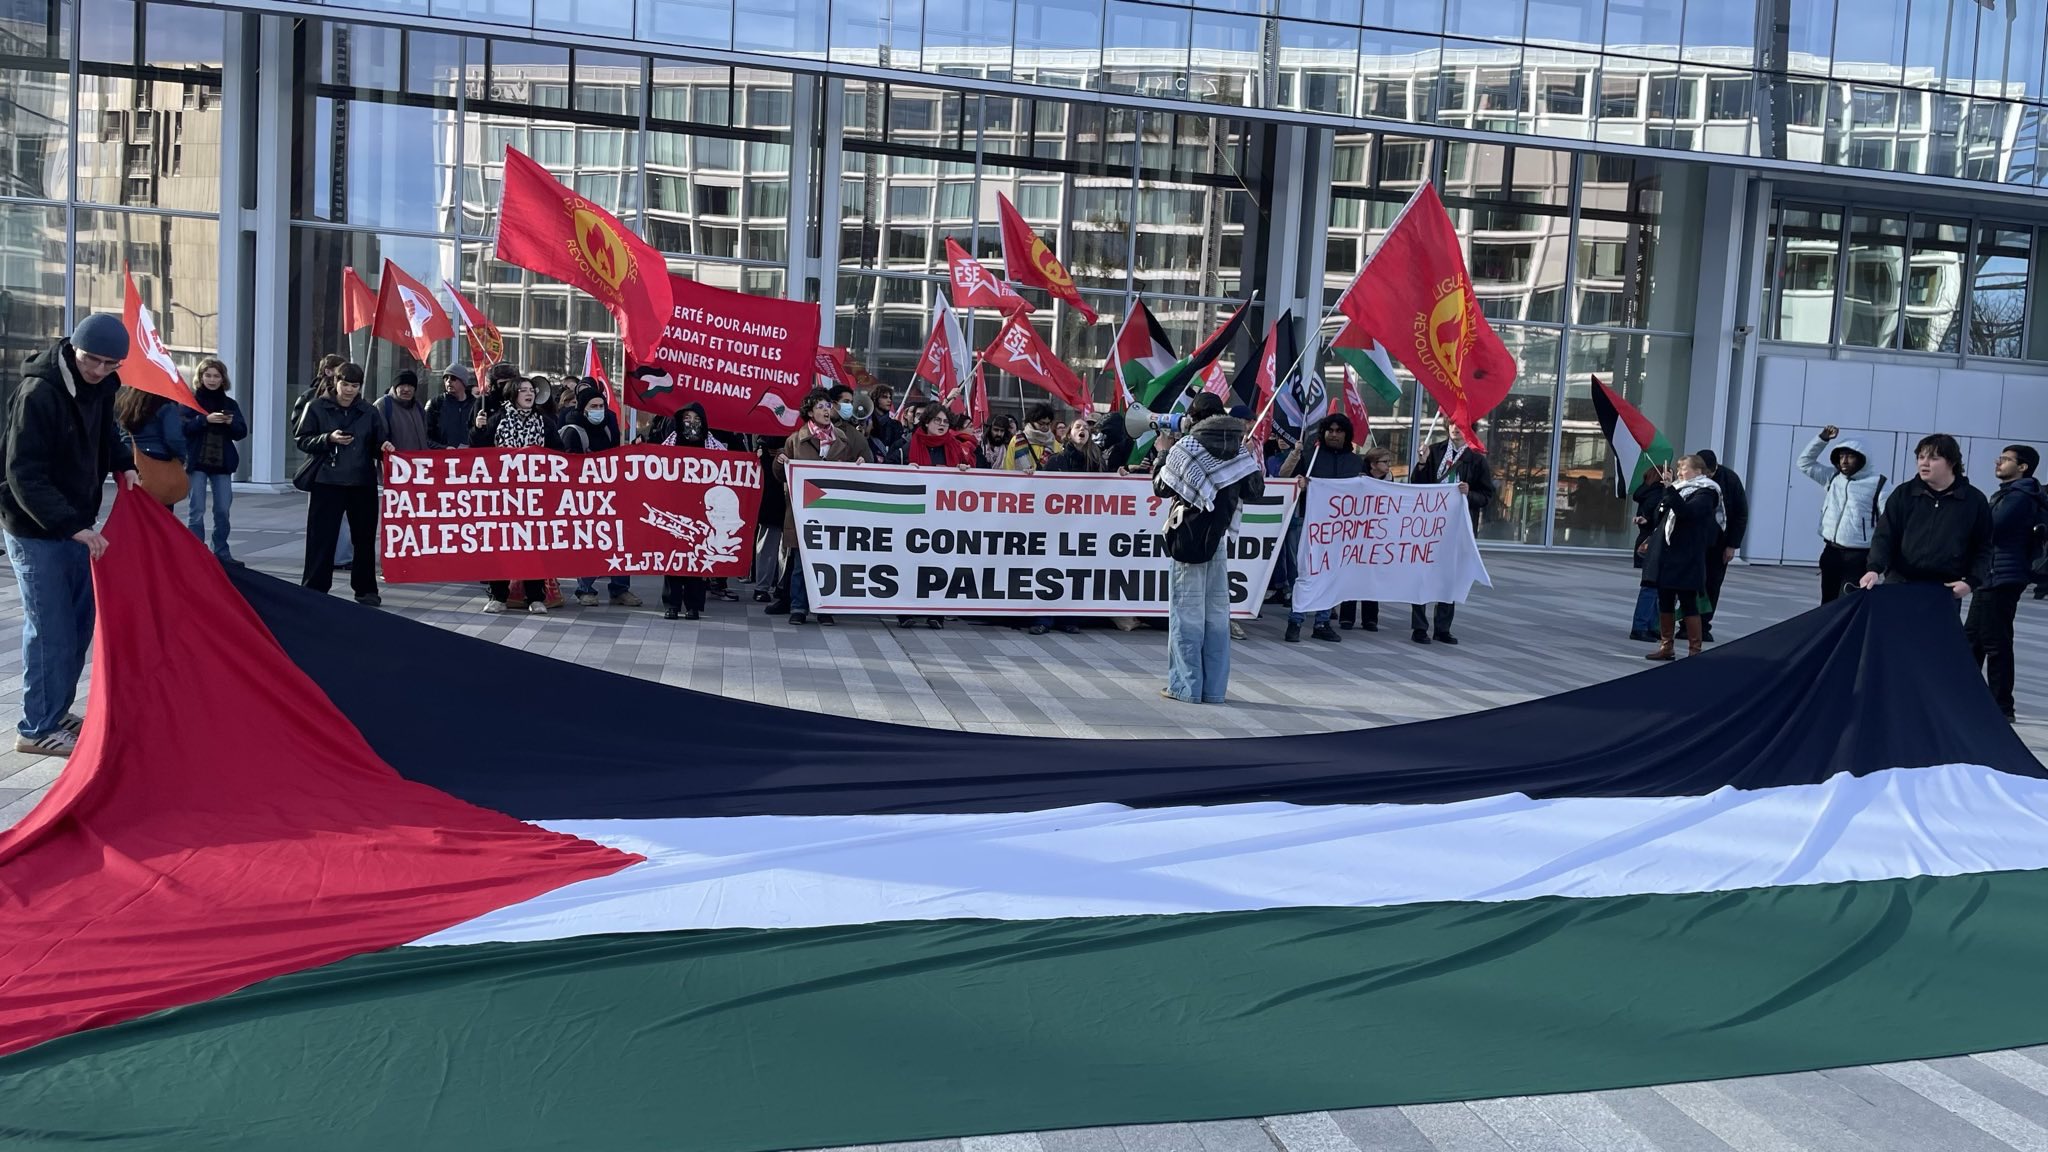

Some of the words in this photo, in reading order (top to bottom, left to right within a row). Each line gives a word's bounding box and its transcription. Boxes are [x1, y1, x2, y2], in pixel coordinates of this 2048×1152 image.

[954, 266, 980, 283] FSE
[1432, 271, 1464, 301] LIGUE
[673, 305, 704, 324] ERTÉ
[706, 313, 740, 332] POUR
[742, 323, 788, 341] AHMED
[662, 325, 707, 346] A'ADAT
[709, 336, 724, 351] ET
[726, 339, 758, 357] TOUT
[761, 346, 782, 361] LES
[1003, 327, 1029, 354] FSE
[655, 346, 714, 371] ONNIERS
[716, 358, 801, 387] PALESTINIENS
[677, 373, 693, 389] ET
[693, 376, 752, 400] LIBANAIS
[389, 455, 434, 485] DE
[445, 457, 493, 485] LA
[499, 454, 570, 483] MER
[578, 455, 618, 484] AU
[624, 454, 761, 489] JOURDAIN
[383, 488, 544, 519] PALESTINE
[555, 490, 617, 516] AUX
[936, 489, 1033, 514] NOTRE
[1044, 493, 1137, 516] CRIME
[1328, 495, 1402, 519] SOUTIEN
[1412, 491, 1450, 514] AUX
[384, 519, 625, 558] PALESTINIENS!
[803, 519, 893, 552] ÊTRE
[905, 528, 1046, 556] CONTRE
[1059, 531, 1097, 557] LE
[1399, 516, 1447, 538] POUR
[1309, 551, 1330, 576] LA
[1340, 540, 1440, 568] PALESTINE
[812, 563, 899, 598] DES
[915, 565, 1249, 604] PALESTINIS
